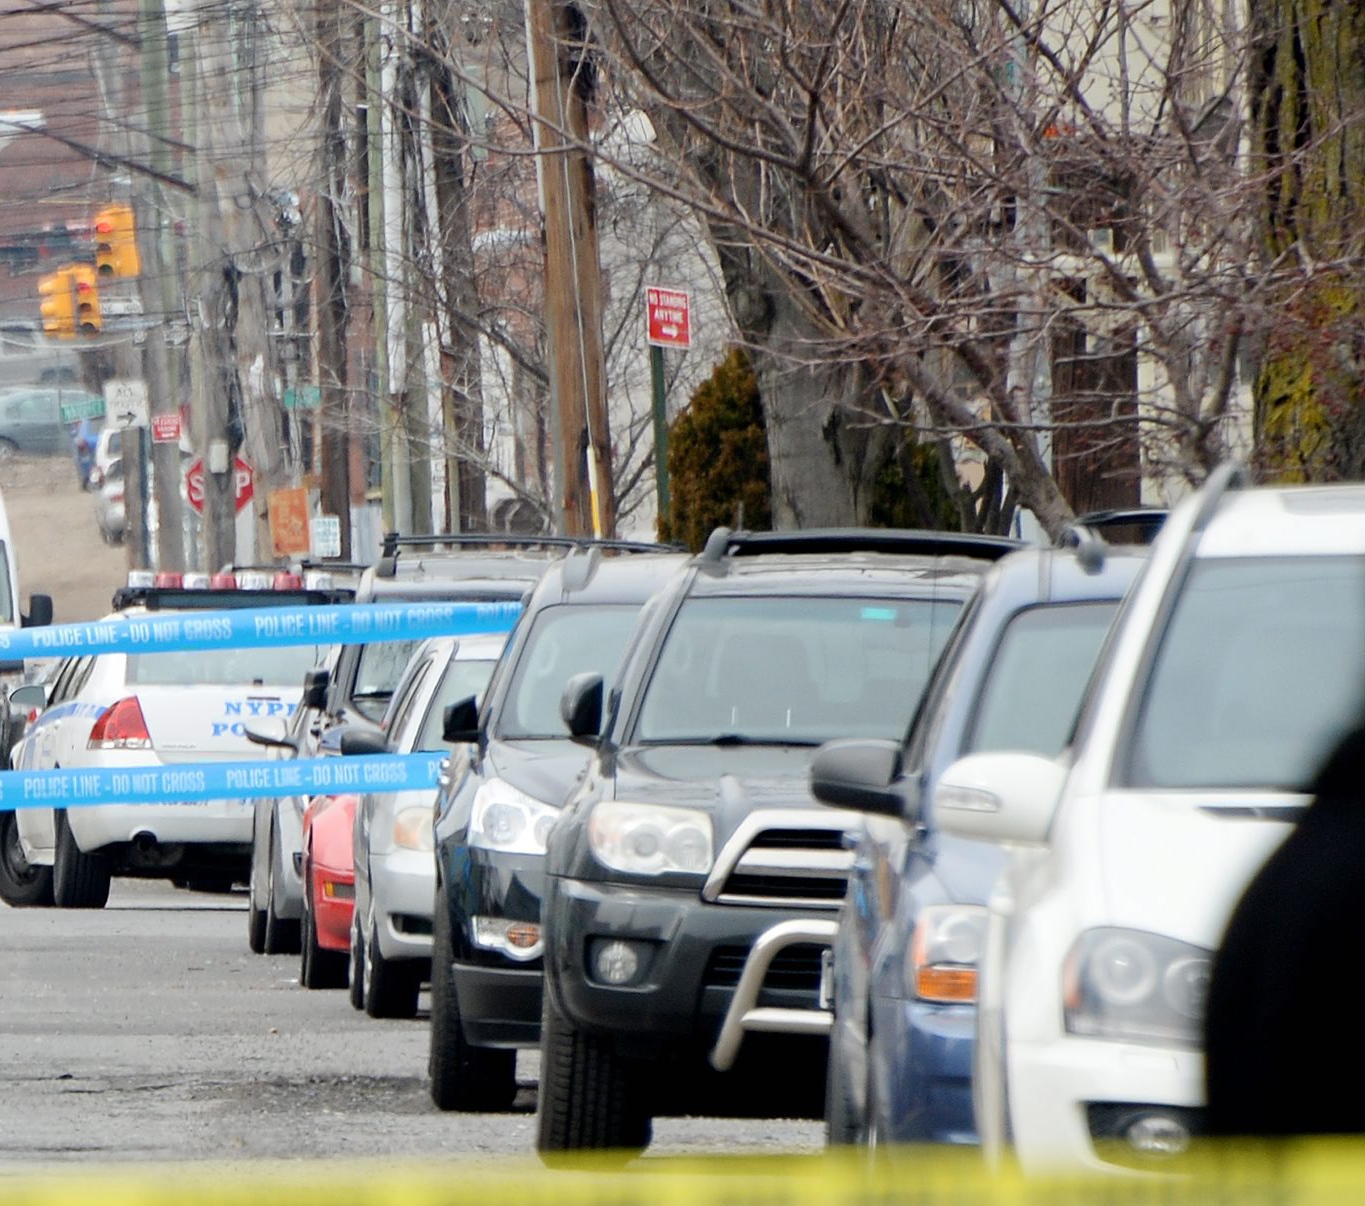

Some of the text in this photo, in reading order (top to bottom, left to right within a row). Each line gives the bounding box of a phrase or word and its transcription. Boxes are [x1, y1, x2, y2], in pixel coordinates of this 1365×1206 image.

[653, 307, 684, 324] ANYTIME
[189, 472, 251, 500] SP
[32, 628, 83, 648] POLICE
[87, 625, 118, 645] LINE
[154, 621, 180, 643] NOT
[183, 617, 233, 640] CROSS
[254, 613, 304, 637] POLICE
[309, 611, 340, 635] LINE
[375, 609, 402, 630] NOT
[407, 606, 453, 627] CROSS
[24, 776, 69, 799] POLICE
[73, 775, 101, 797] LINE
[133, 773, 158, 794] NOT
[162, 770, 205, 793] CROSS
[227, 768, 271, 790] POLICE
[274, 766, 302, 788] LINE
[334, 763, 361, 785] NOT
[364, 761, 407, 784] CROSS
